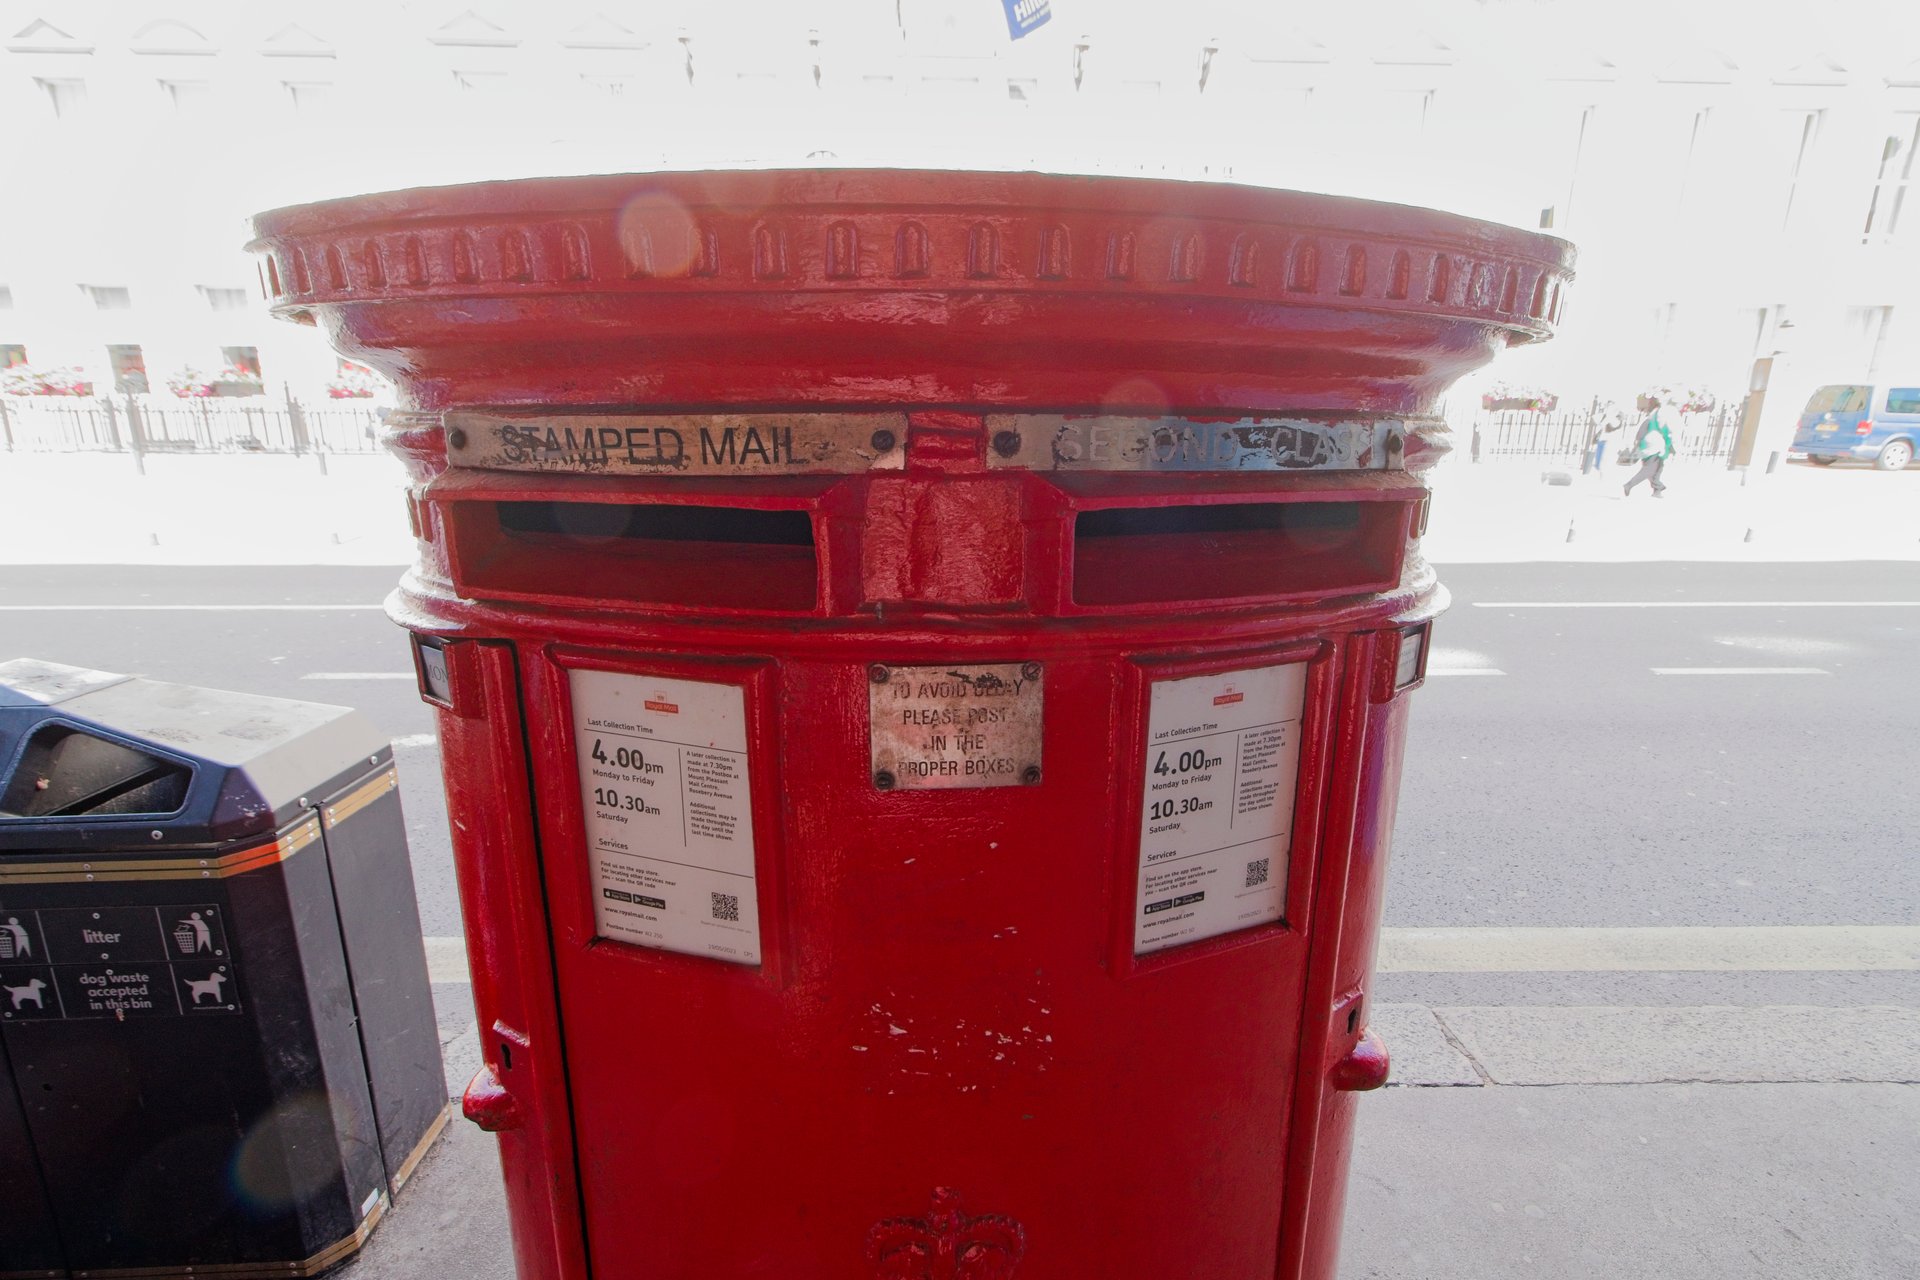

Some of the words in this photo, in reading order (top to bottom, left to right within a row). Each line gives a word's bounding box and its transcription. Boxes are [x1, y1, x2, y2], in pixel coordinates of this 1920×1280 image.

[501, 424, 684, 465] STAMPED
[700, 426, 806, 465] MAIL
[1052, 424, 1237, 462] SECOND
[917, 681, 966, 698] AVOID
[974, 679, 1024, 697] DELY
[646, 702, 663, 711] Royal
[664, 704, 676, 712] Mail
[1214, 696, 1230, 704] Royal
[903, 708, 961, 725] PLEASE
[968, 708, 1007, 724] POST
[588, 718, 601, 726] Last
[604, 720, 635, 731] Collection
[637, 725, 653, 734] Time
[1170, 726, 1200, 736] Collection
[931, 735, 946, 751] IN
[954, 734, 985, 750] THE
[592, 738, 664, 774] 4.00pm
[704, 754, 730, 762] collection
[1154, 749, 1222, 776] 4.00pm
[710, 762, 732, 771] 7.30pm
[898, 760, 958, 777] PROPER
[965, 758, 1015, 776] BOXES
[592, 768, 620, 781] Monday
[632, 775, 654, 786] Friday
[706, 776, 728, 784] Pleasant
[712, 770, 732, 778] Postbox
[1152, 780, 1180, 790] Monday
[1190, 774, 1212, 784] Friday
[594, 787, 660, 815] 10.30am
[689, 788, 712, 797] Rosebery
[714, 792, 732, 800] Avenue
[690, 802, 716, 810] Additional
[1150, 797, 1212, 820] 10.30am
[596, 810, 628, 824] Saturday
[690, 809, 717, 818] collections
[706, 818, 735, 828] throughout
[1149, 822, 1180, 834] Saturday
[598, 838, 628, 850] Services
[1147, 850, 1176, 862] Services
[604, 906, 658, 921] www.royalmail.com
[1143, 912, 1194, 928] www.royalmail.com
[82, 929, 122, 944] litter
[79, 973, 107, 987] dog
[110, 974, 150, 984] waste
[88, 985, 148, 999] accepted
[90, 1000, 103, 1010] in
[106, 998, 129, 1010] this
[132, 998, 152, 1008] bin
